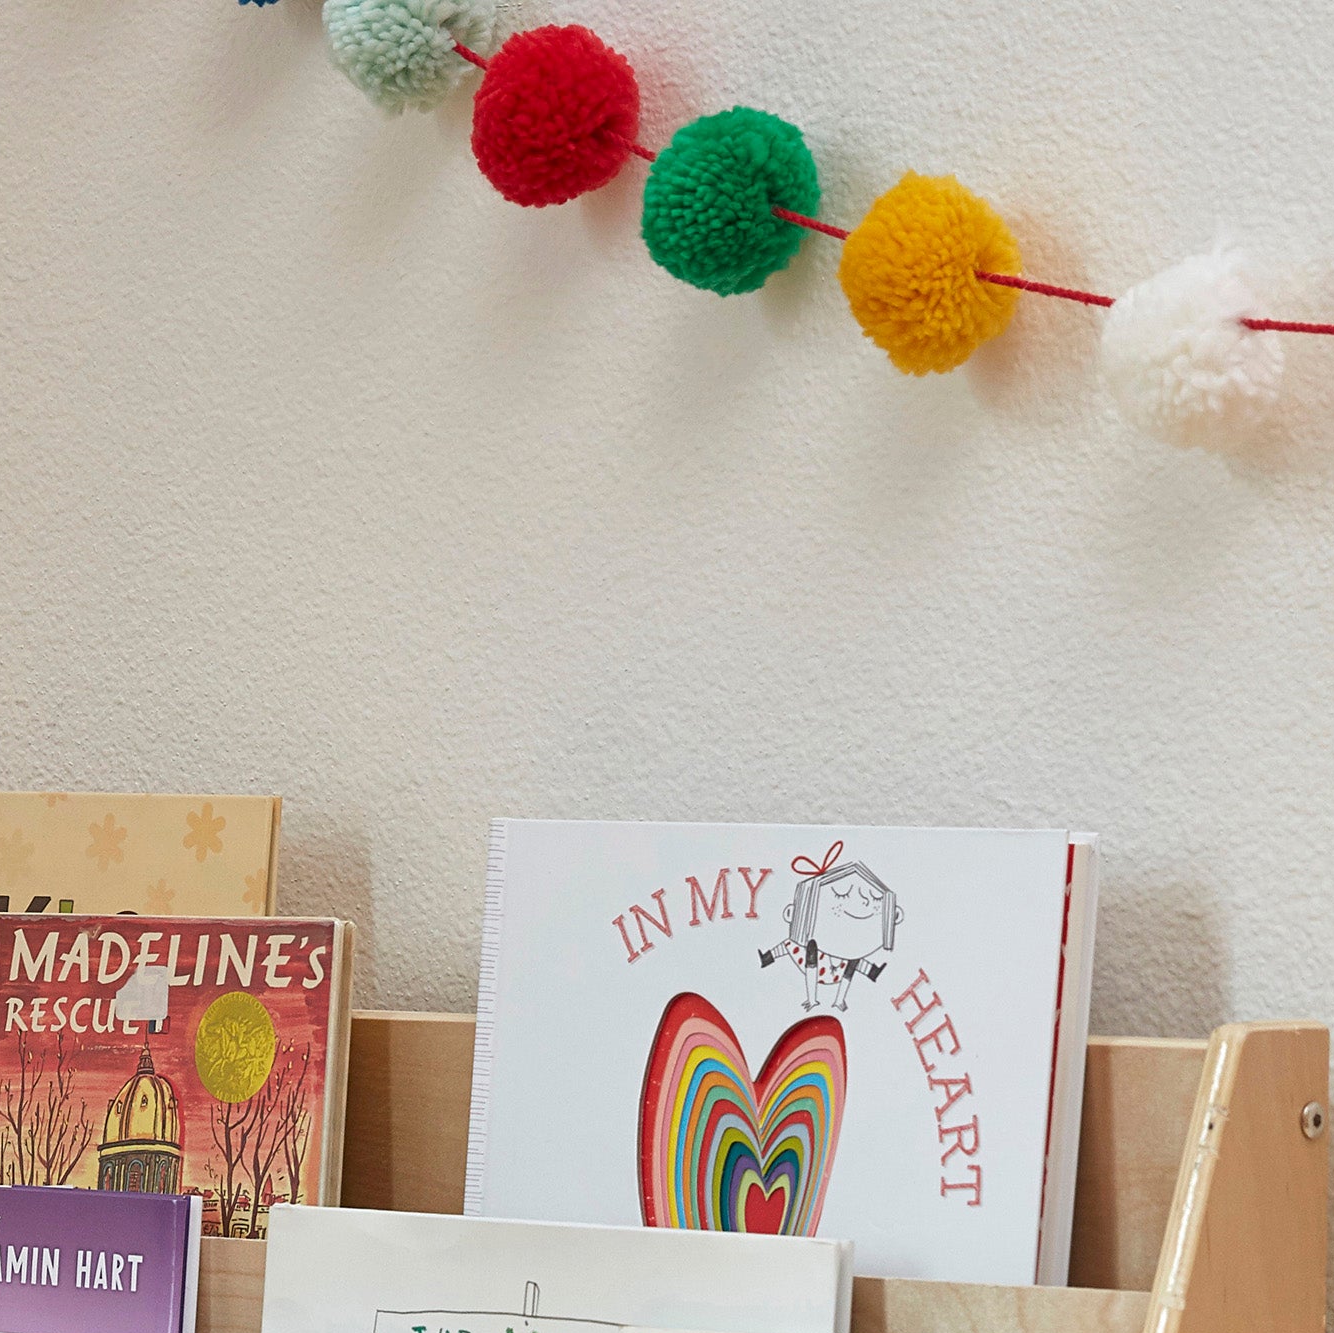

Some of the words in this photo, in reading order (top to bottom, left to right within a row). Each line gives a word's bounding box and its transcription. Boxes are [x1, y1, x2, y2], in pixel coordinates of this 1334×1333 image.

[612, 888, 672, 964] IN
[685, 867, 772, 928] MY
[891, 968, 983, 1207] HEART
[75, 1250, 144, 1293] HART
